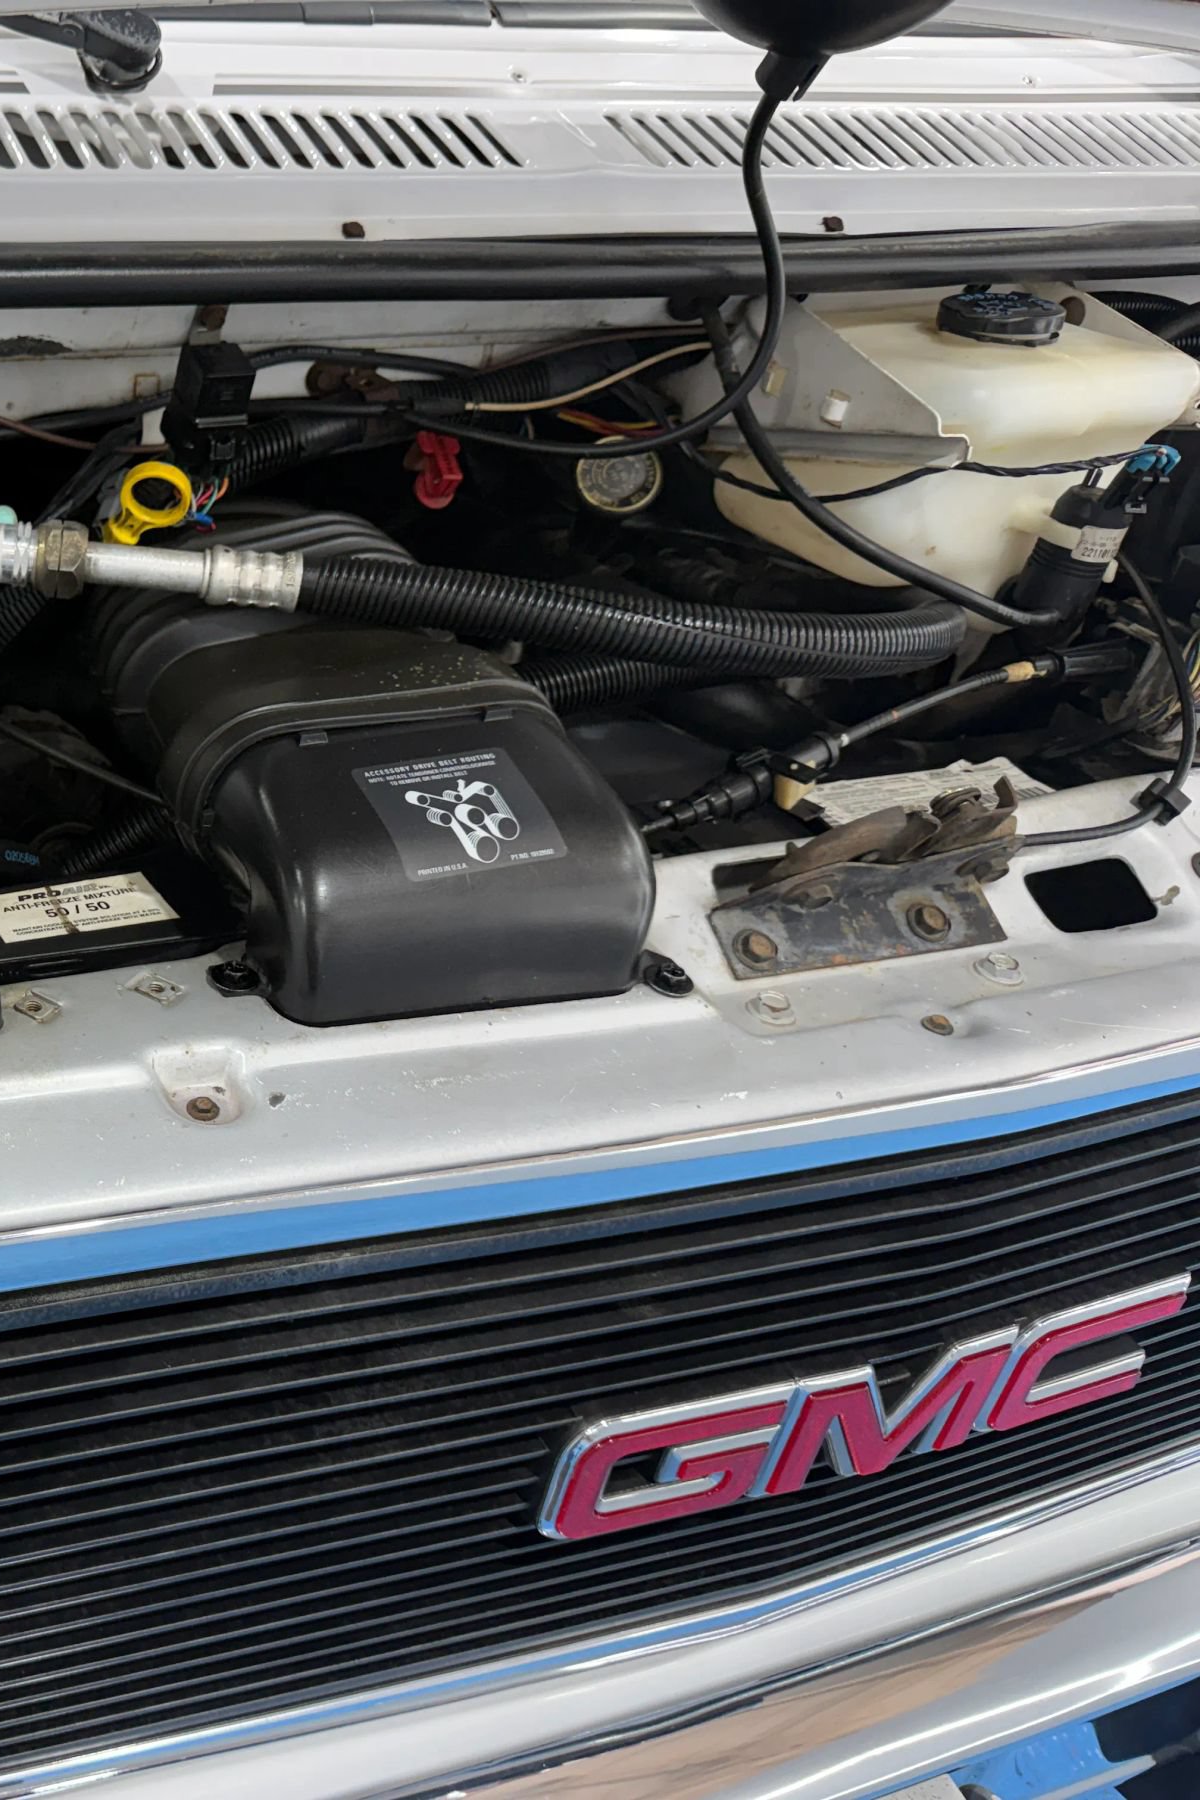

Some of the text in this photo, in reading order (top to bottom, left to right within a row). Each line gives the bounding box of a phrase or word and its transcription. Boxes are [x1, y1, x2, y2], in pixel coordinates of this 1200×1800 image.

[364, 753, 495, 778] ACCESSORY DRIVE BELT ROUTING
[417, 866, 443, 876] PRINTED
[83, 886, 136, 900] MIXTURE
[44, 906, 70, 918] 50
[85, 900, 111, 912] 50
[537, 1271, 1191, 1540] GMC
